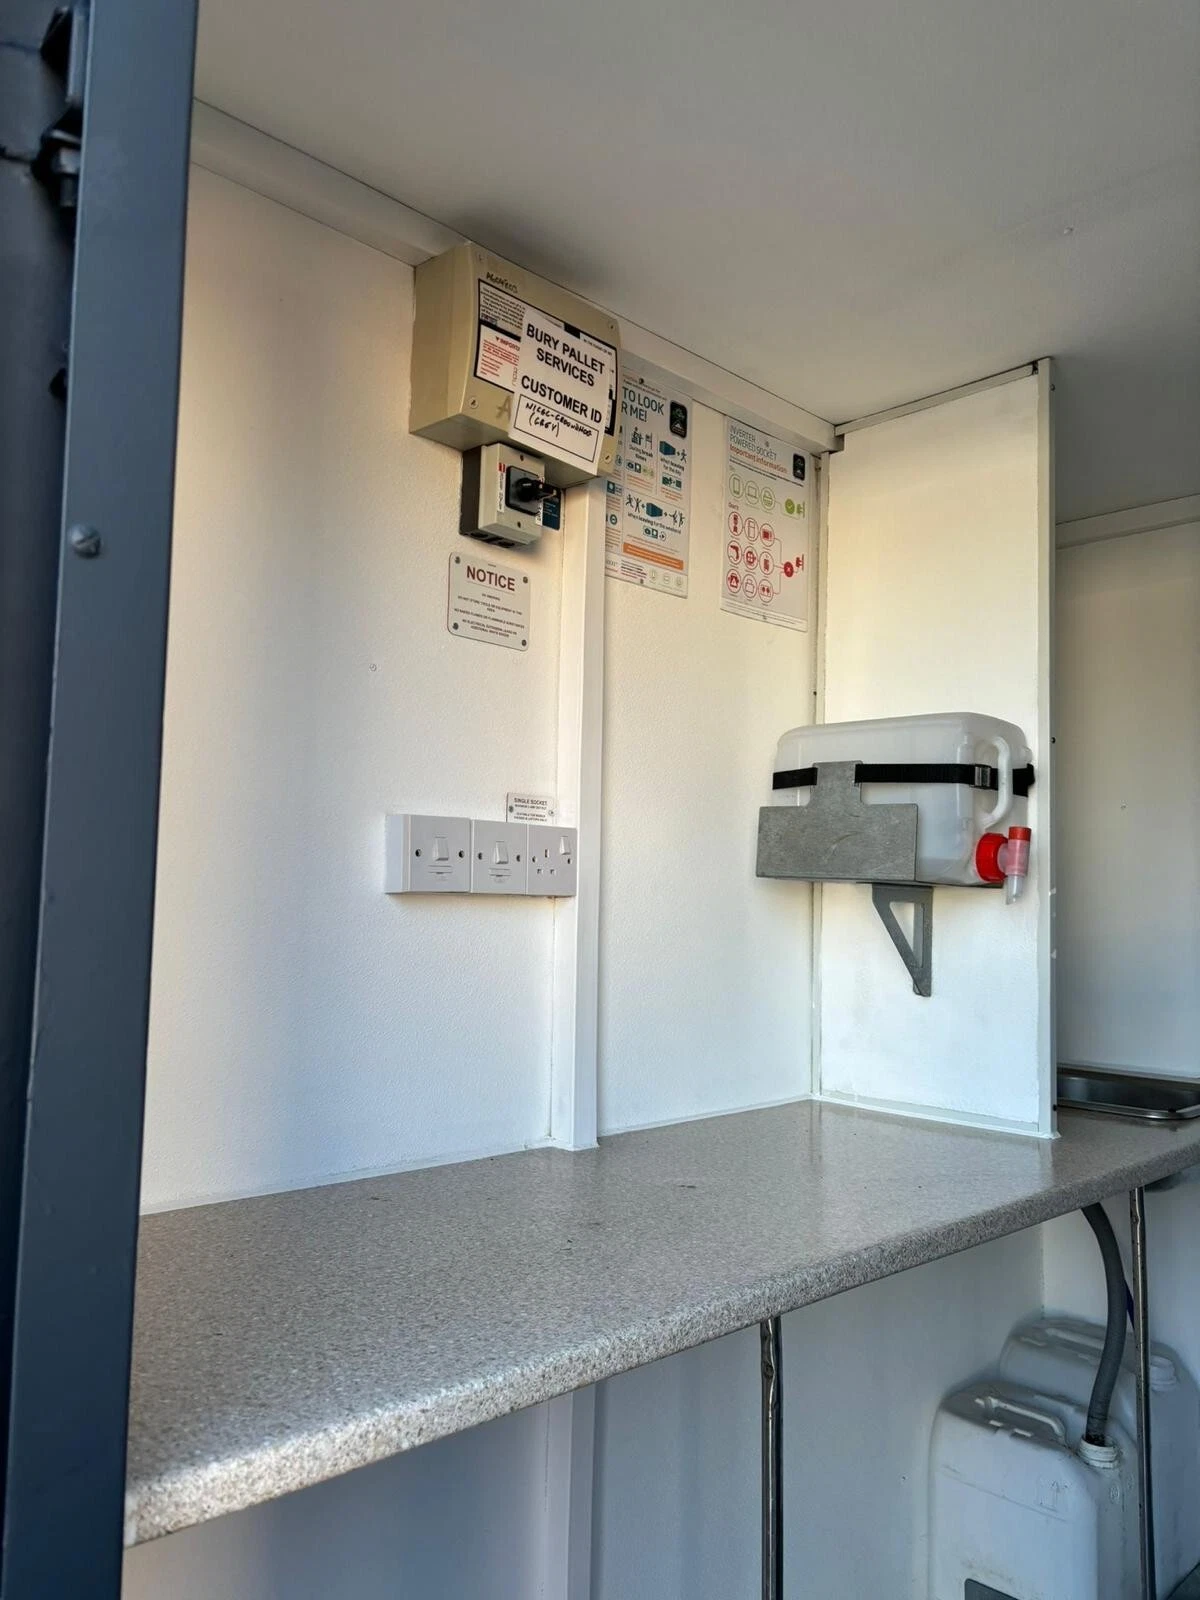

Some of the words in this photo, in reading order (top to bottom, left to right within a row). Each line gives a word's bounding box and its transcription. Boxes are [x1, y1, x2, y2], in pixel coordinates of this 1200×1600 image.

[526, 323, 560, 348] BURY
[562, 342, 605, 374] PALLET
[536, 347, 595, 387] SERVICES
[521, 375, 589, 418] CUSTOMER
[590, 408, 603, 424] ID
[622, 386, 636, 402] TO
[637, 393, 665, 416] LOOK
[629, 404, 648, 423] ME!
[729, 434, 755, 452] POWERED
[729, 444, 755, 463] Important
[466, 565, 516, 592] NOTICE
